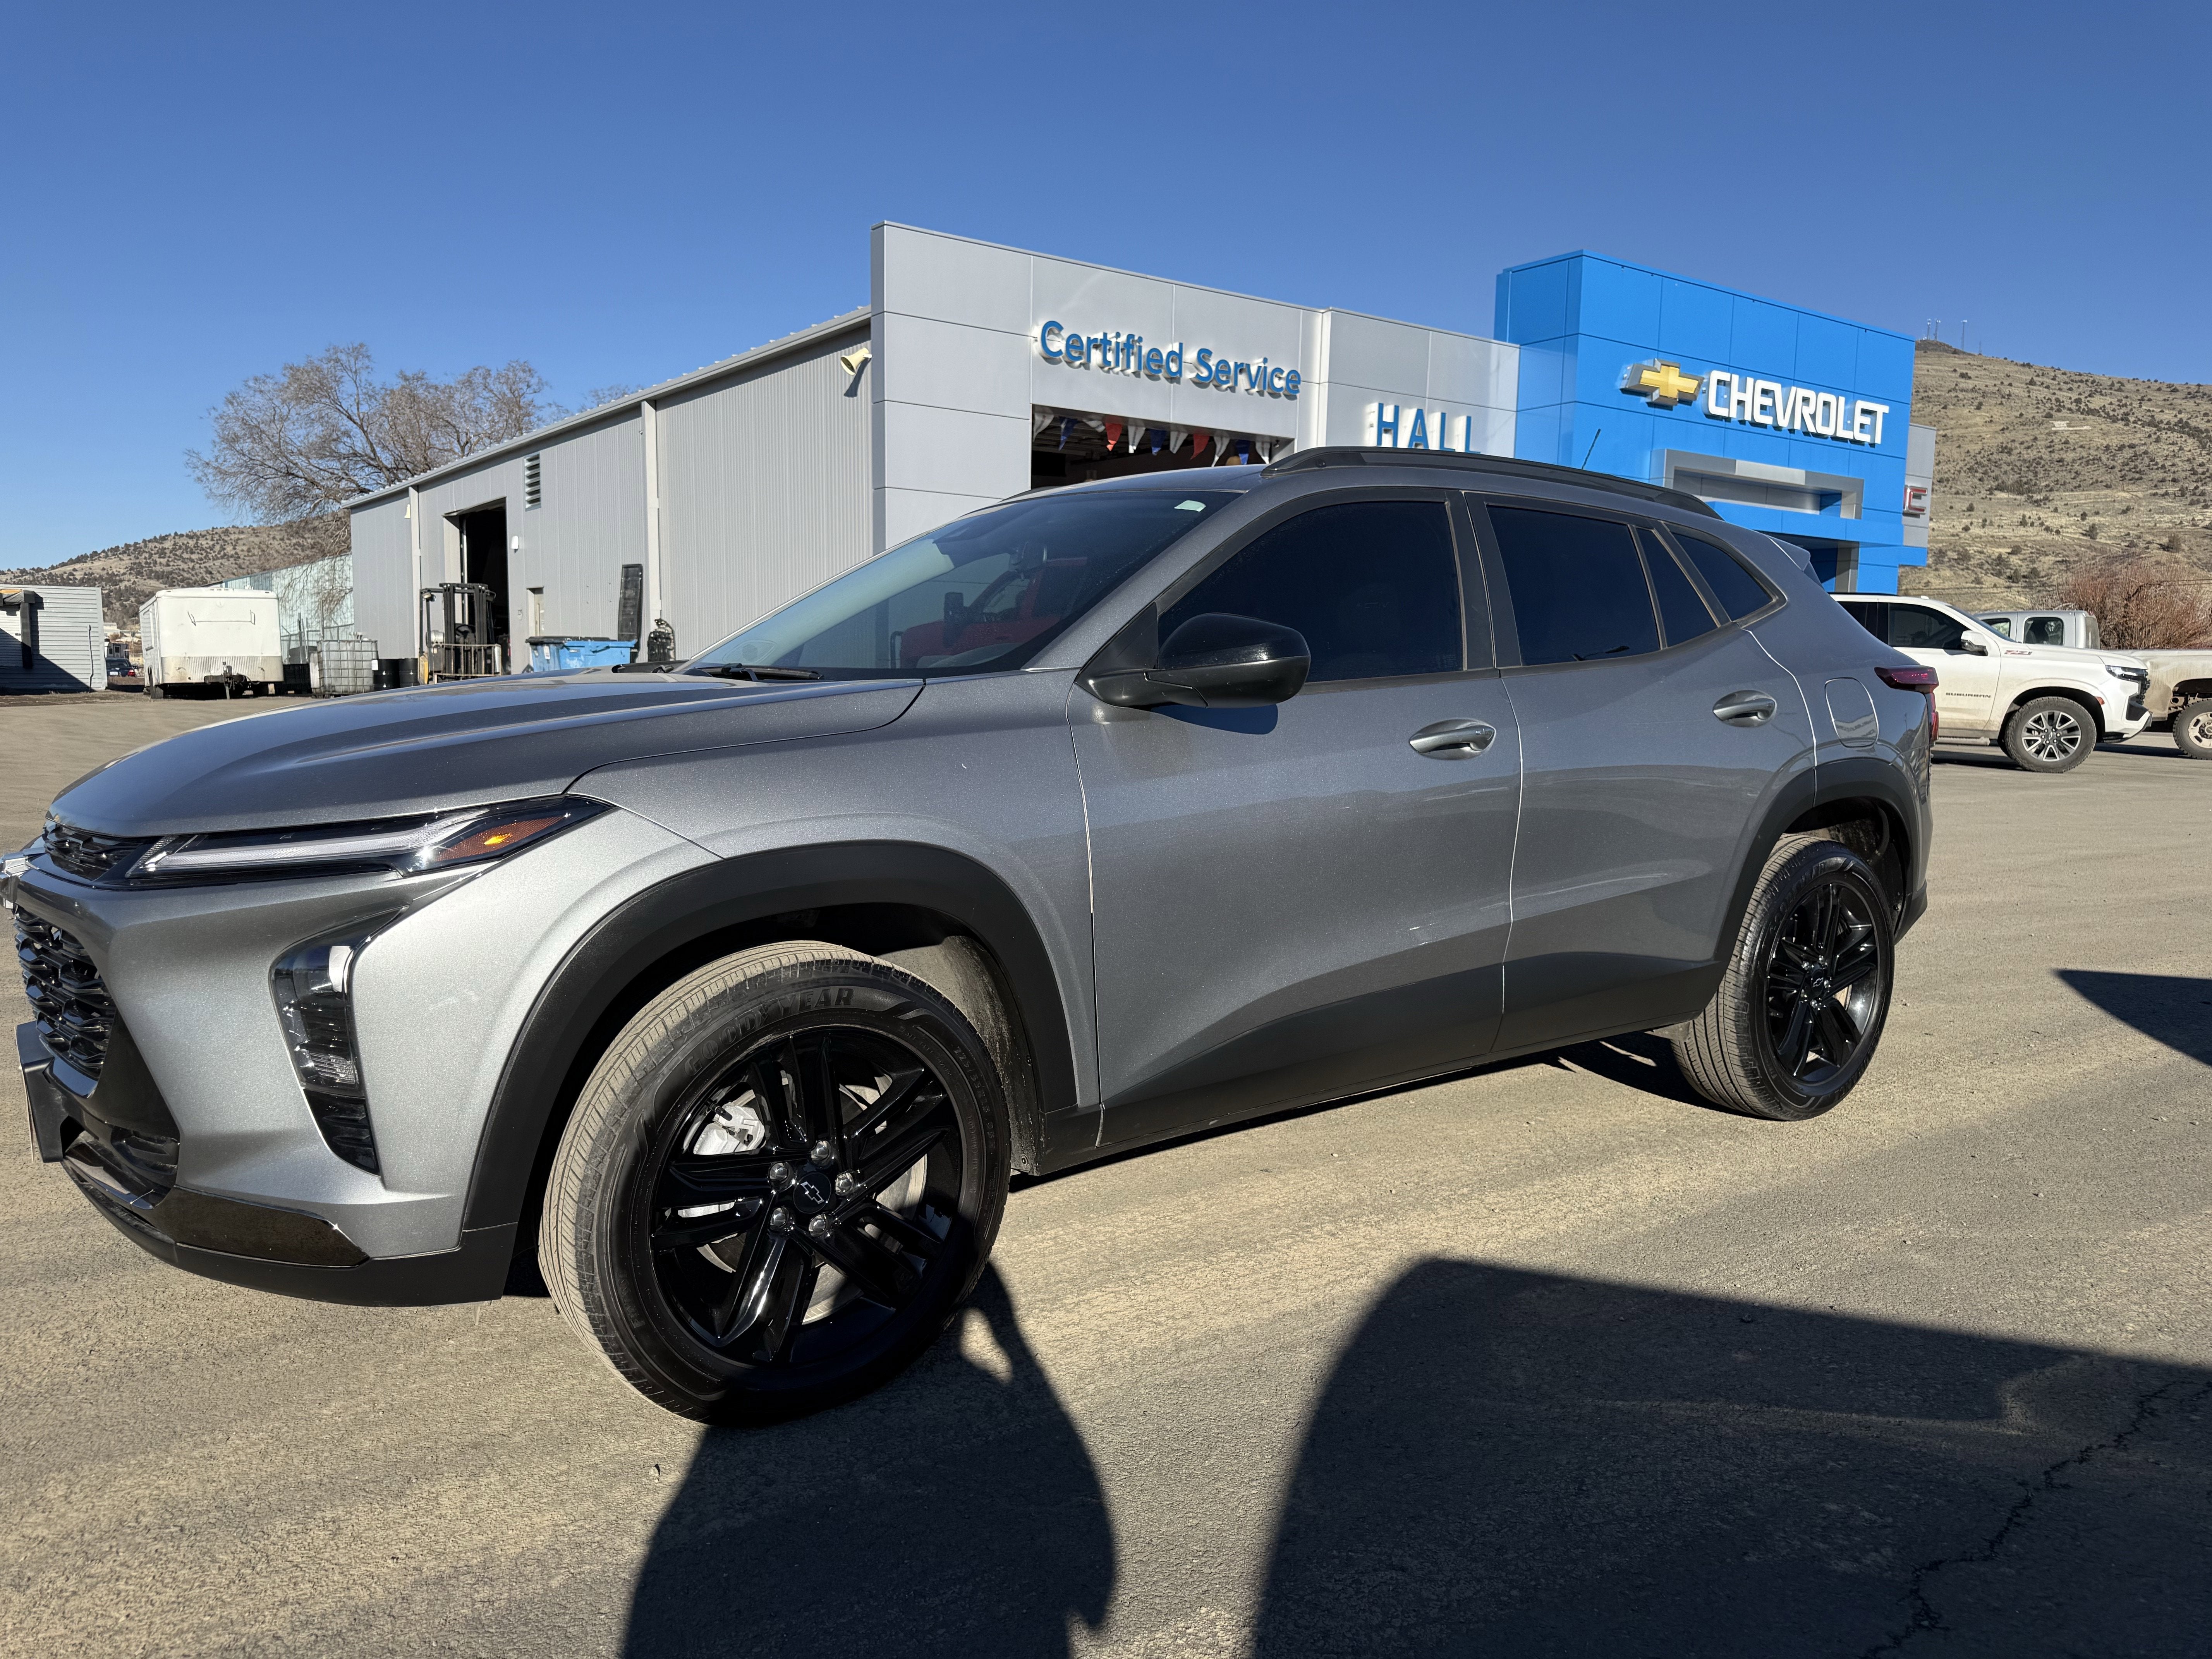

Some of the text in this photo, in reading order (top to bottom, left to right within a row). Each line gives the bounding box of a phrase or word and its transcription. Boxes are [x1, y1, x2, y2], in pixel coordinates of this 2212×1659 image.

[1041, 321, 1301, 395] Certified Service
[1377, 403, 1480, 454] HALL
[1708, 370, 1889, 444] CHEVROLET
[684, 988, 855, 1076] GOODYEAR
